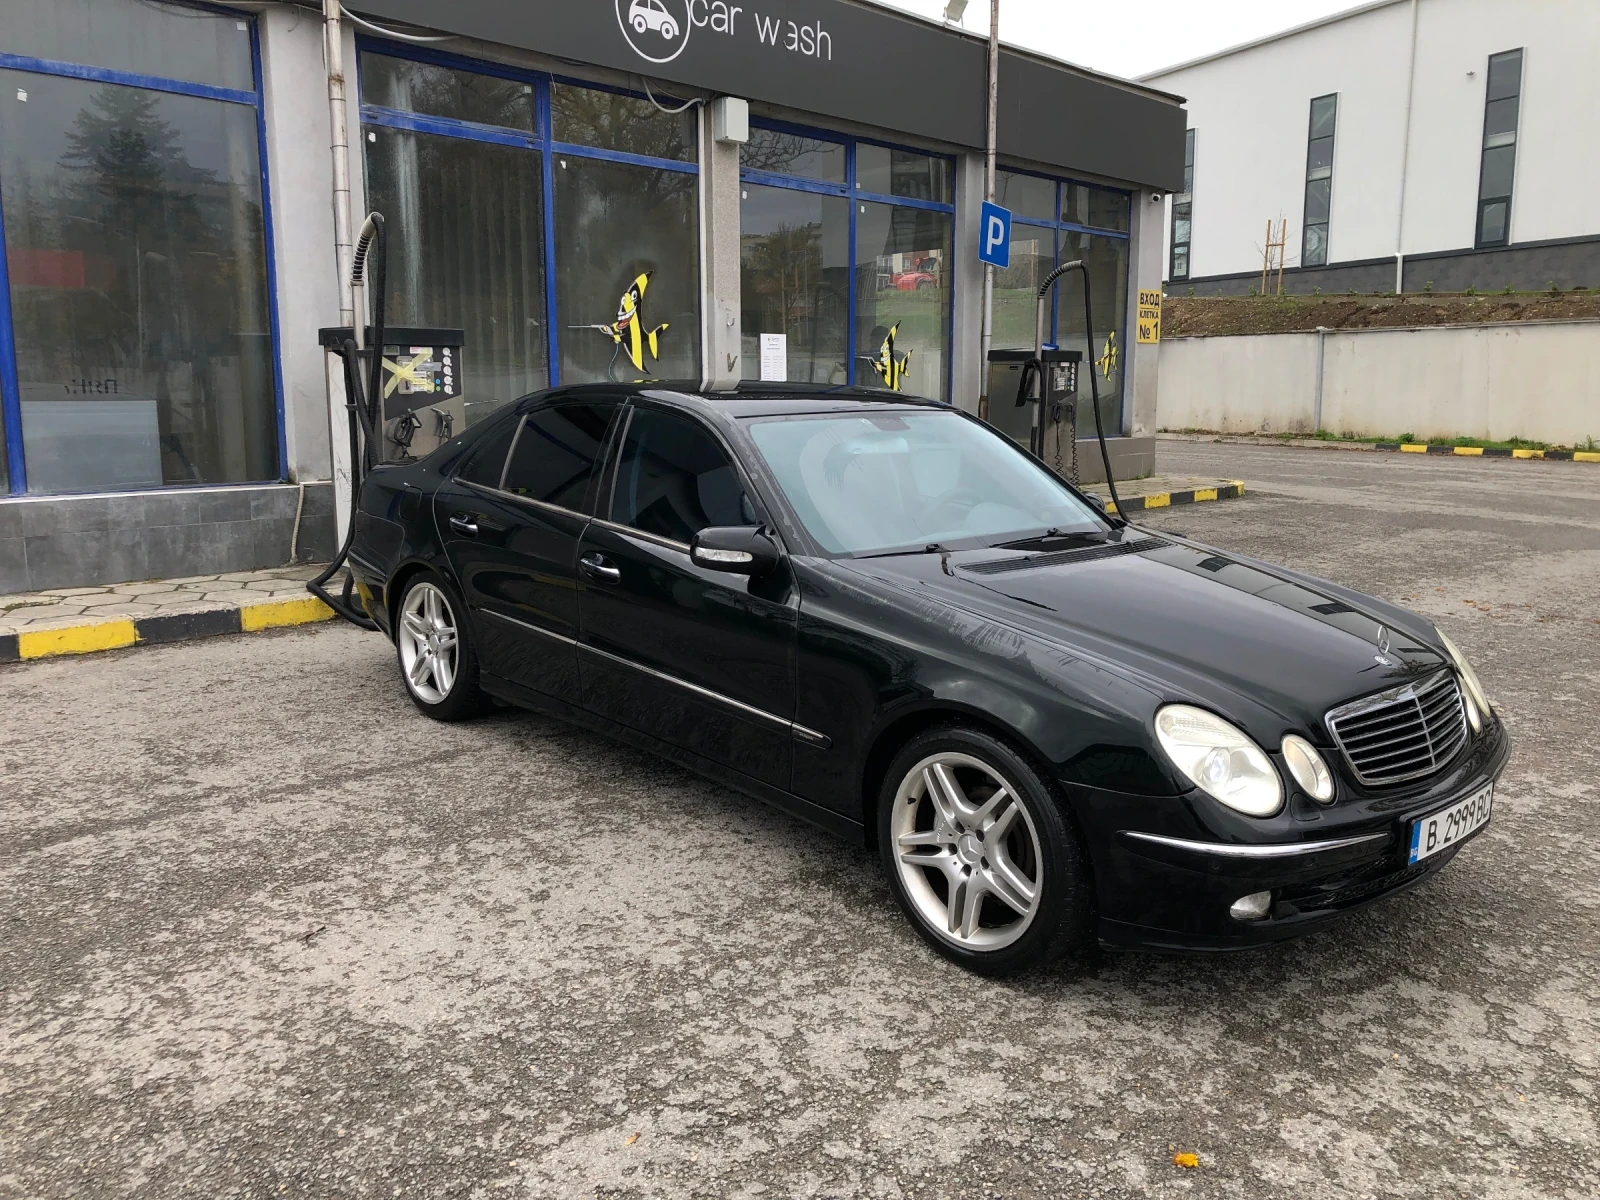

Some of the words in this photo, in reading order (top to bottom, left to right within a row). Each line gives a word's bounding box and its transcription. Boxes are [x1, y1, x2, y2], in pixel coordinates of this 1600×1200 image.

[690, 0, 743, 36] car
[754, 12, 832, 61] wash
[986, 215, 1005, 256] P
[1139, 292, 1160, 308] ВХОД
[1139, 309, 1160, 319] КЛЕТКА
[1153, 321, 1159, 340] 1
[1443, 799, 1476, 844] 2999
